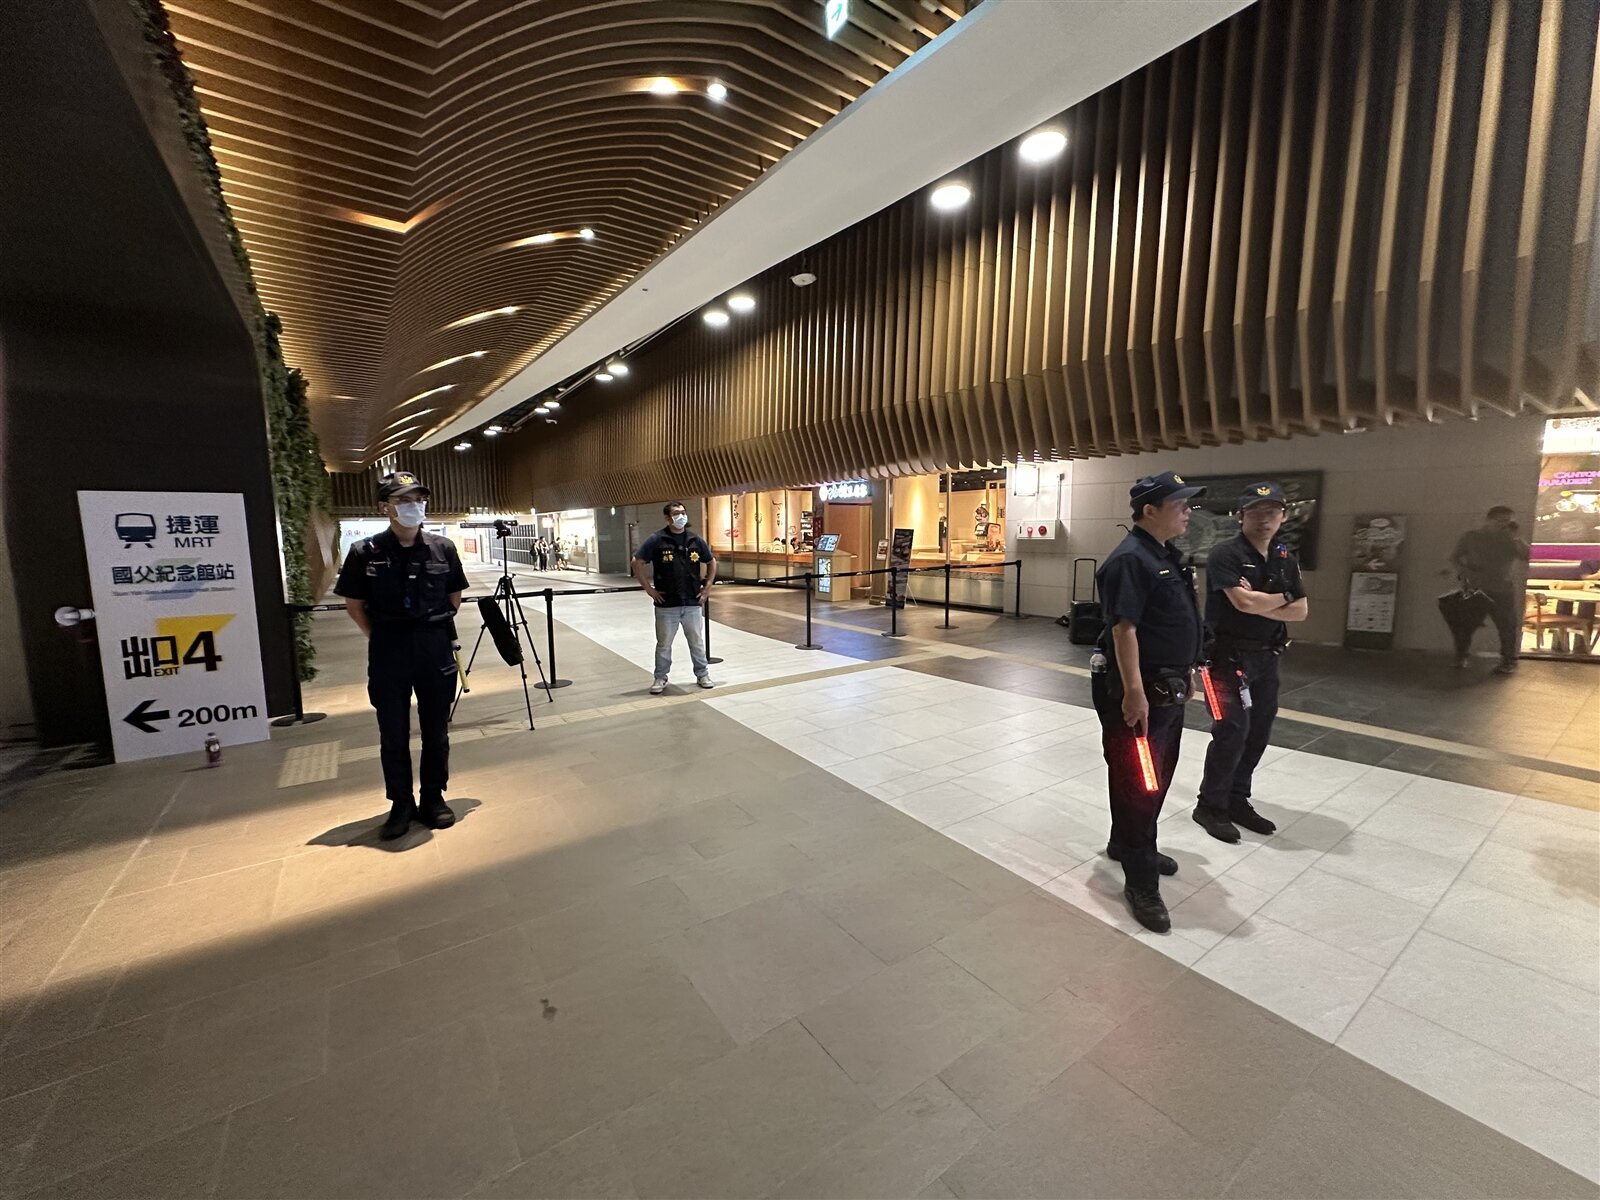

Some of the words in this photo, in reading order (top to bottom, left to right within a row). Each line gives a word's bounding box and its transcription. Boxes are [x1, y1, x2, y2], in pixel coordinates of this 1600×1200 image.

[166, 515, 220, 534] 捷運
[174, 536, 216, 548] MRT
[112, 563, 235, 585] 國父紀念館站
[154, 666, 179, 677] EXIT
[178, 704, 258, 728] 200m
